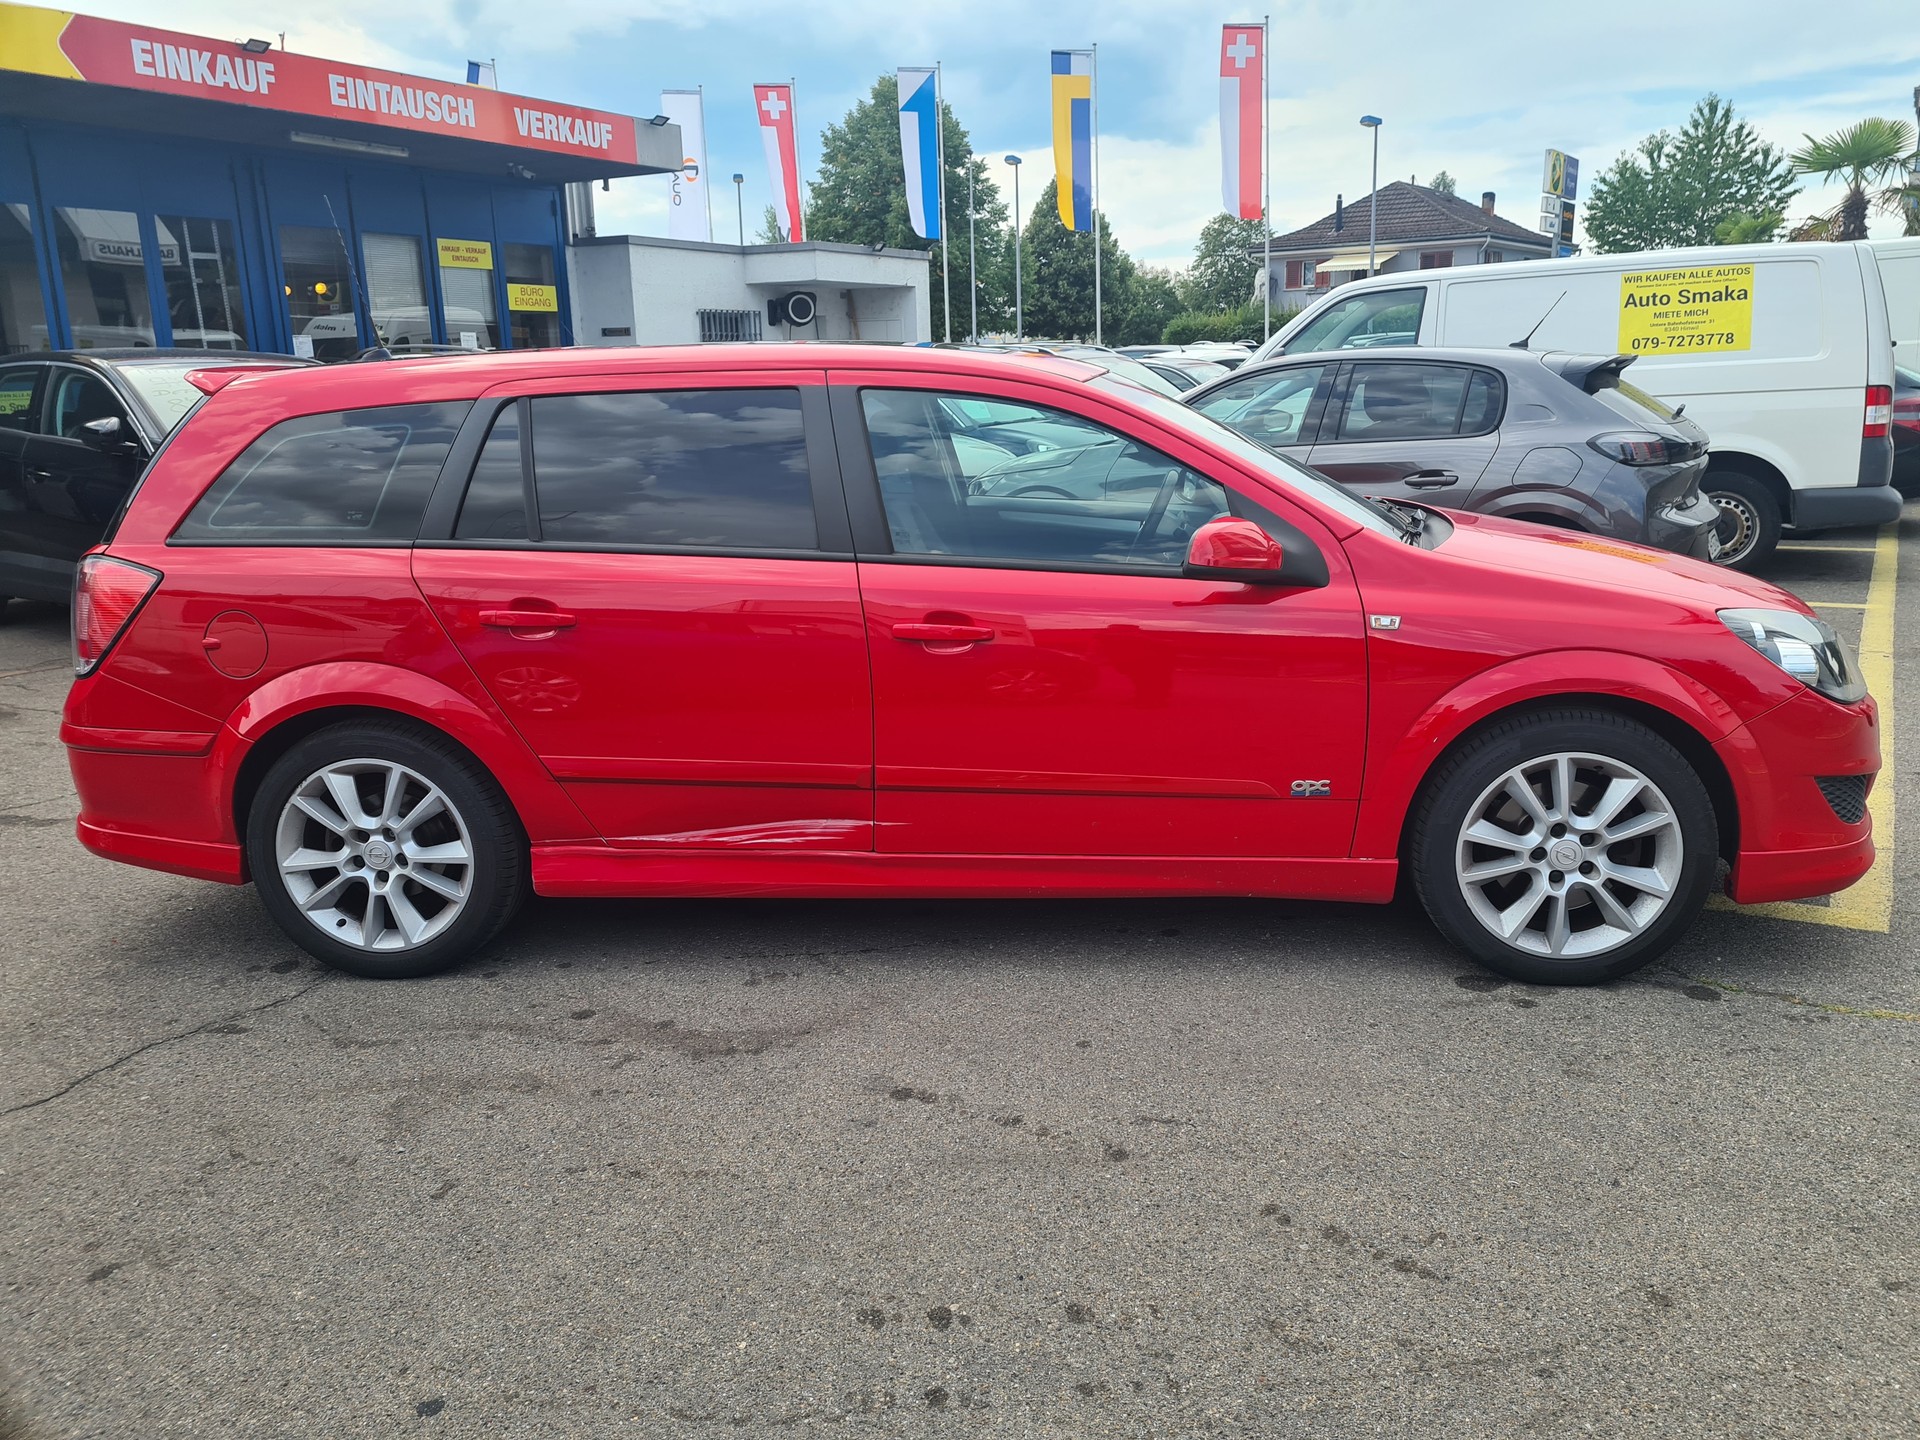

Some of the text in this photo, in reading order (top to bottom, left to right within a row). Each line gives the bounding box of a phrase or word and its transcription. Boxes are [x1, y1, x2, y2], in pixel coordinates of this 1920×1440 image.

[131, 38, 612, 149] EINKAUF EINTAUSCH VERKAUF
[441, 245, 460, 253] ANKAUF
[465, 247, 487, 255] VERKAUF
[452, 255, 479, 263] EINTAUSCH
[1624, 267, 1751, 284] WIR KAUFEN ALLE AUTOS
[521, 286, 544, 297] BÜRO
[1624, 285, 1749, 308] Auto Smaka
[515, 297, 552, 308] EINGANG
[1653, 308, 1709, 319] MIETE MICH
[1631, 332, 1735, 350] 079-7273778
